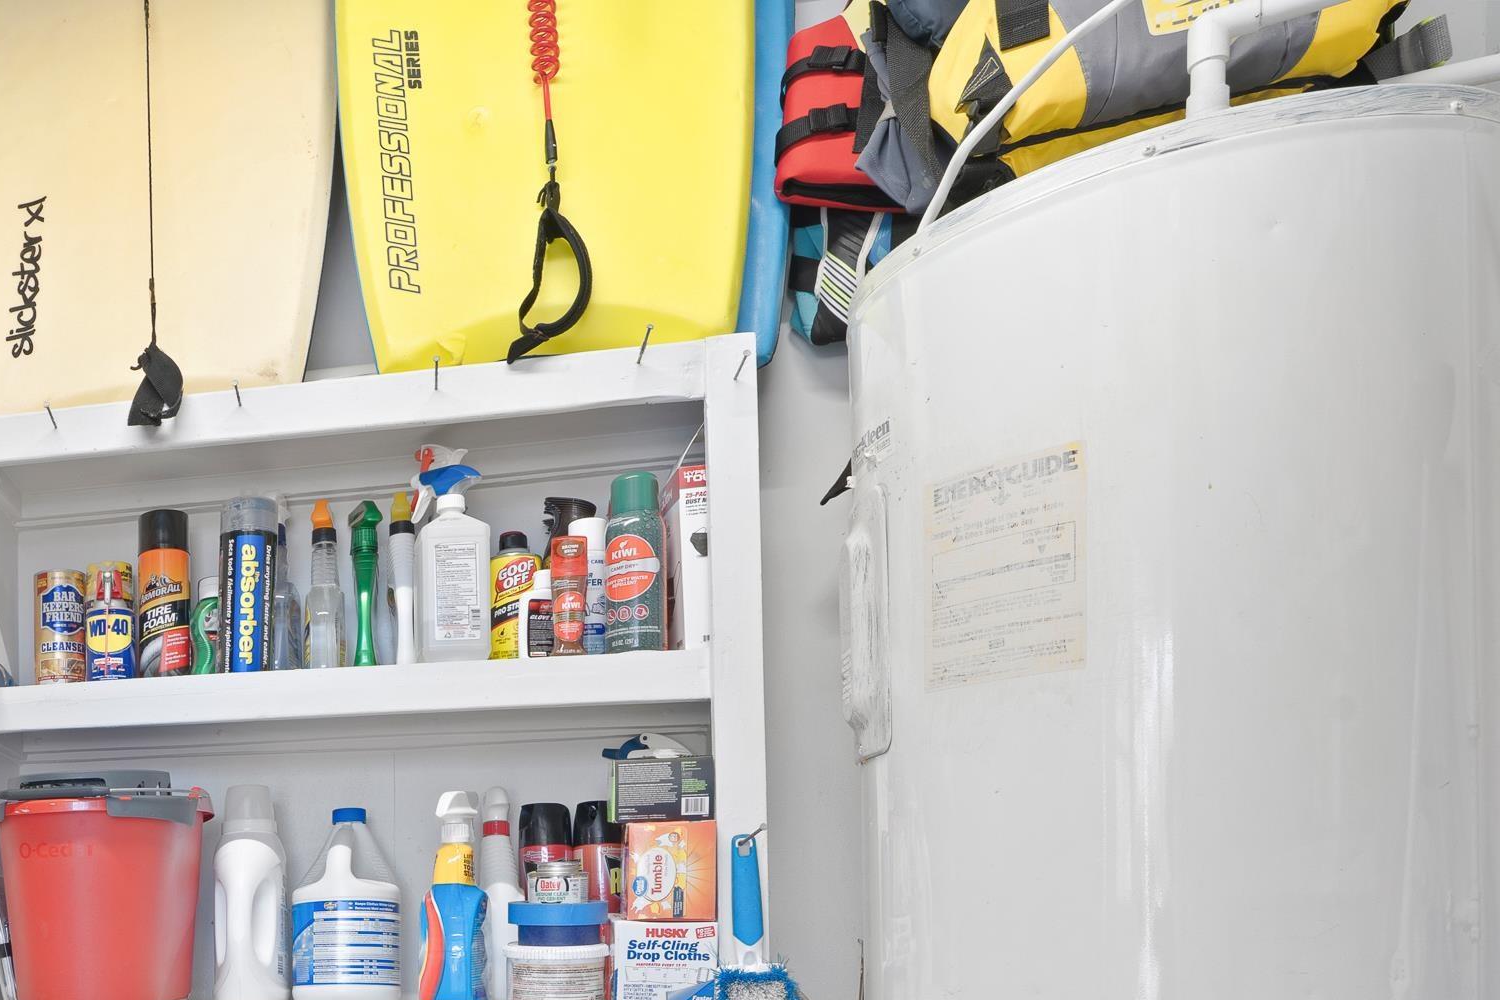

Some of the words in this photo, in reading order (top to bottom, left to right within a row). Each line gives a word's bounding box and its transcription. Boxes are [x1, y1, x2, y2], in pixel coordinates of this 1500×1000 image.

[404, 30, 422, 90] SERIES
[372, 29, 421, 294] PROFESSIONAL
[17, 195, 47, 227] xl
[6, 230, 42, 359] slickster
[611, 547, 637, 560] KIWI
[498, 559, 534, 580] GOOF
[264, 566, 272, 600] anything
[503, 573, 530, 589] OFF
[53, 591, 76, 602] BAR
[239, 543, 259, 665] absorber
[43, 601, 84, 614] KEEPERS
[146, 603, 172, 619] TIRE
[494, 608, 507, 618] PRO
[562, 602, 581, 610] KIWI
[45, 612, 83, 623] FRIEND
[143, 612, 176, 632] FOAM
[89, 618, 129, 637] WD-40
[651, 854, 664, 895] Tumble
[646, 928, 689, 938] HUSKY
[628, 940, 700, 952] Self-Cling
[627, 950, 660, 962] Drop
[664, 951, 710, 961] Cloths
